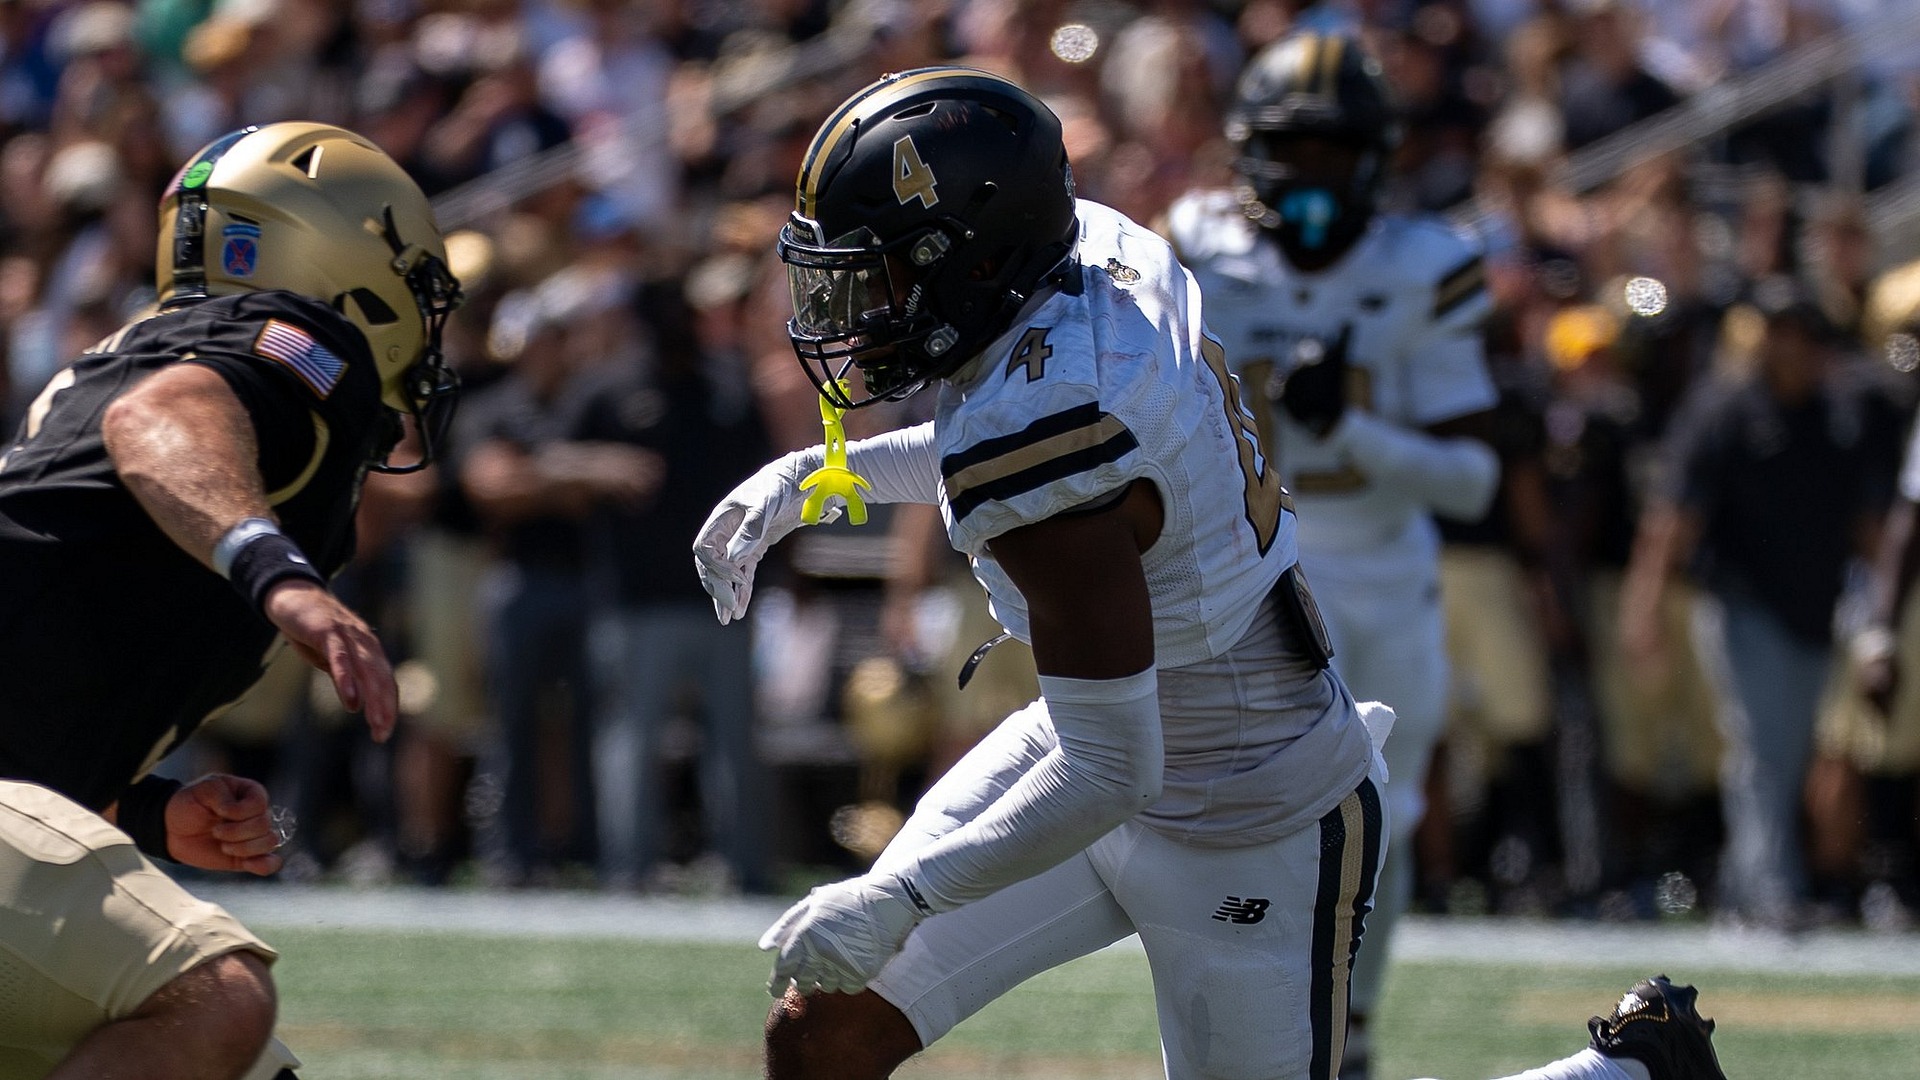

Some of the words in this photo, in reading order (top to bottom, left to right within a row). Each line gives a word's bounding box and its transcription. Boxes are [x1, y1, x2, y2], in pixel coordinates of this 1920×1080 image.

[893, 134, 939, 210] 4
[1004, 326, 1053, 384] 4
[1212, 895, 1271, 925] NB
